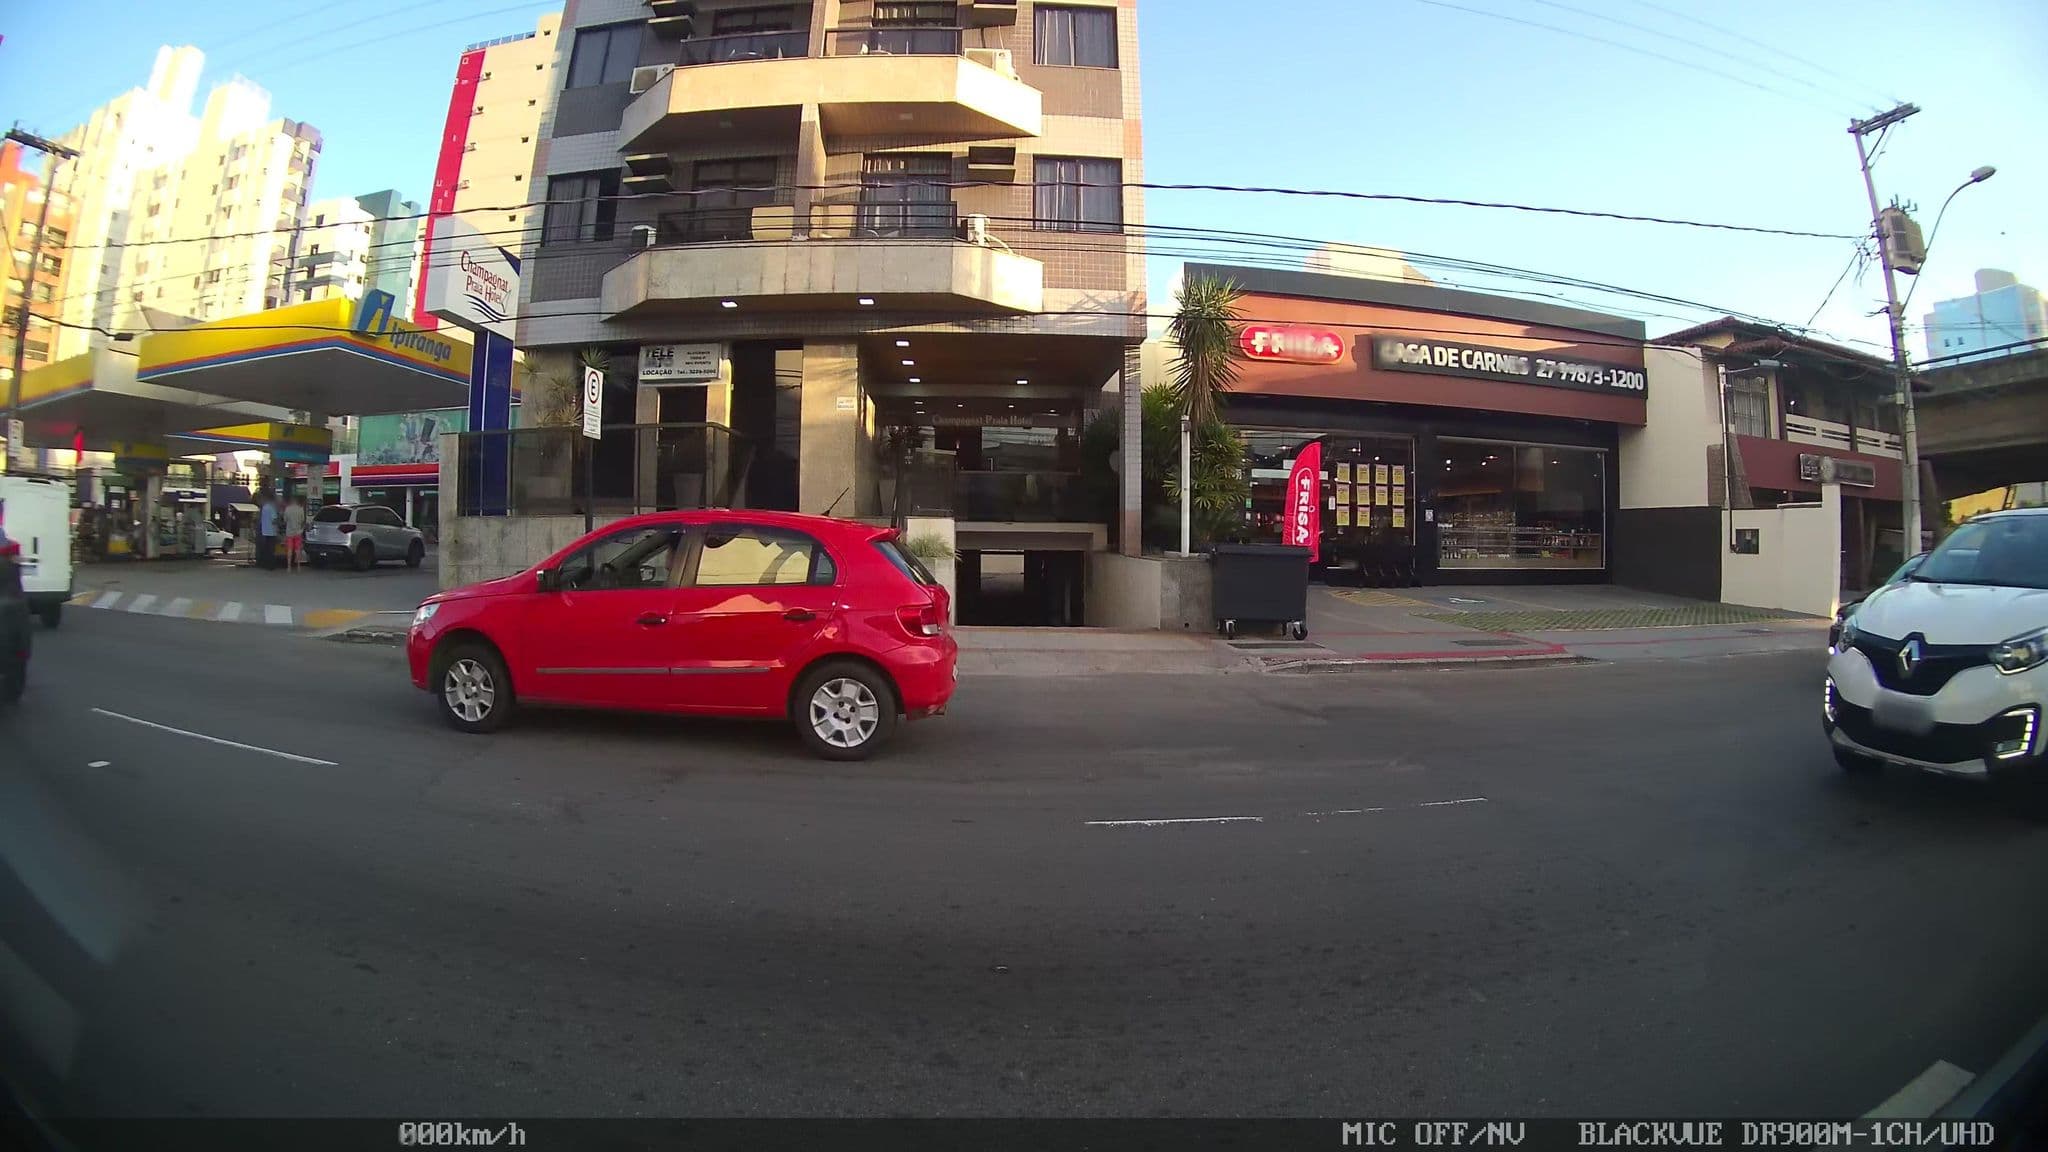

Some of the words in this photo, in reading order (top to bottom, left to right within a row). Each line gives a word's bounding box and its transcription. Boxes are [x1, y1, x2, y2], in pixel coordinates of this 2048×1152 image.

[461, 250, 509, 292] Champagnat
[466, 275, 483, 294] Praia
[390, 321, 452, 362] Ipiranga
[1250, 331, 1340, 359] FRA
[1381, 341, 1432, 365] ASA
[1433, 346, 1460, 368] DE
[1536, 359, 1555, 378] 27
[642, 367, 673, 376] LOCAÇÃO
[1296, 476, 1315, 544] FRISA
